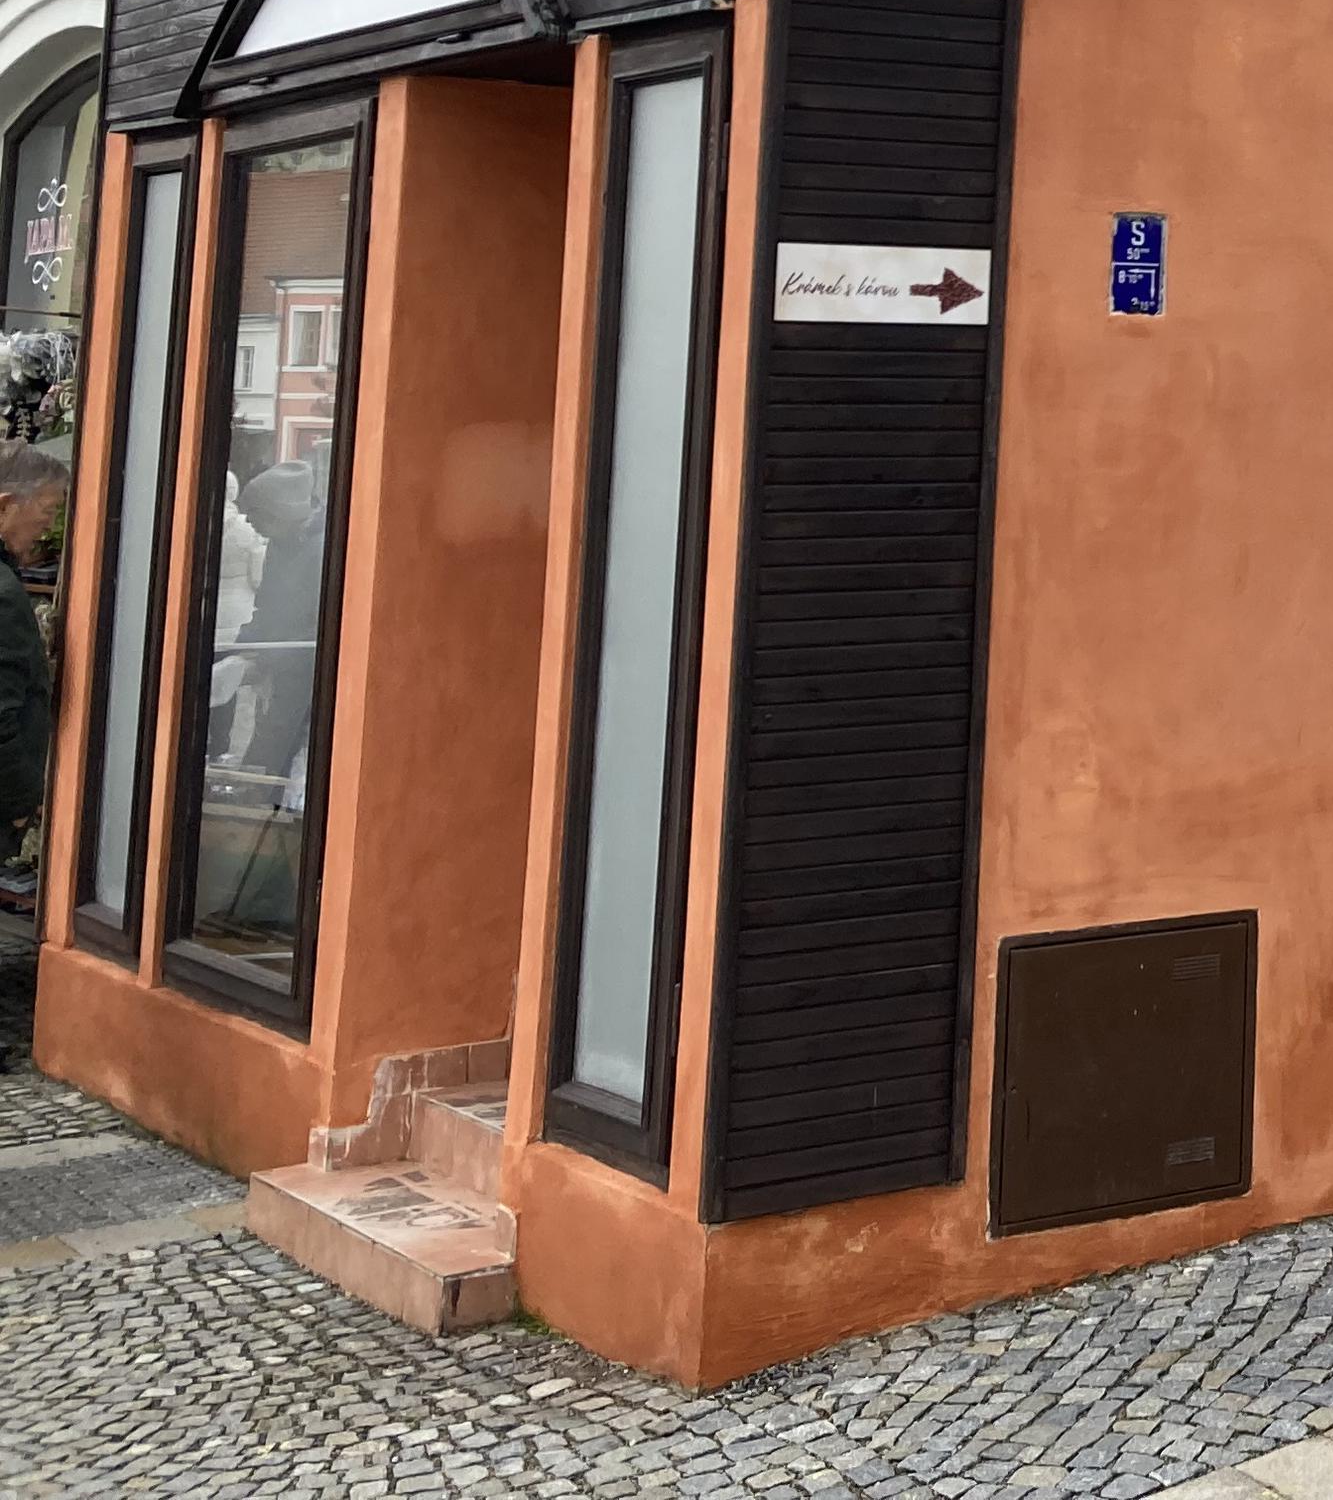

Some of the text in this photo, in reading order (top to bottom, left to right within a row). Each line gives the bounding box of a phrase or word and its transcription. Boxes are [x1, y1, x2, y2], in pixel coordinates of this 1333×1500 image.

[1131, 221, 1146, 246] S
[781, 272, 846, 296] Krámek
[855, 276, 900, 297] kávou
